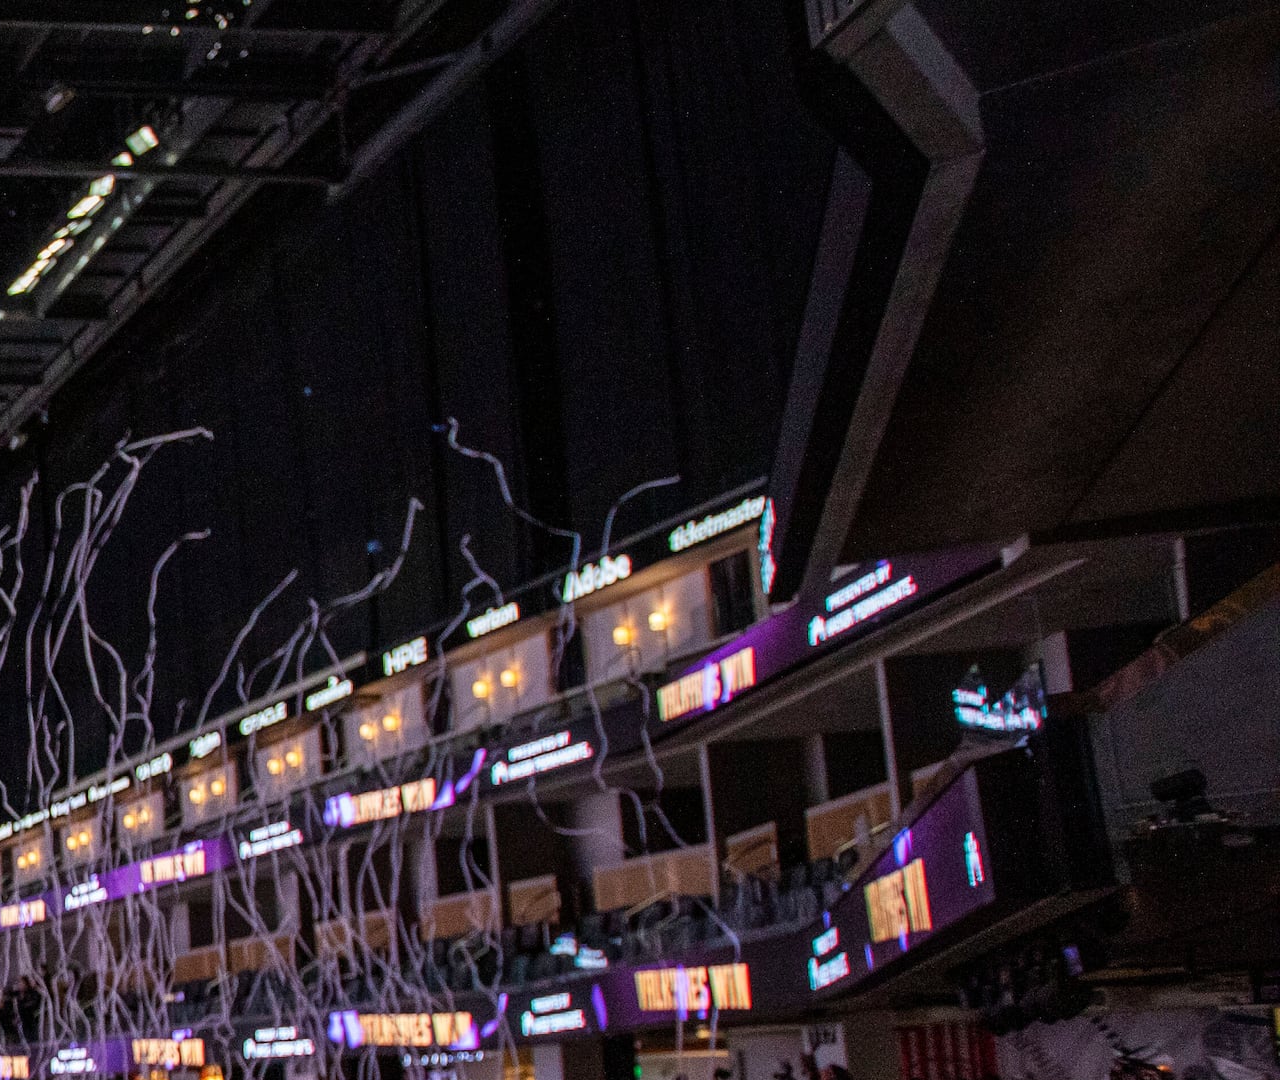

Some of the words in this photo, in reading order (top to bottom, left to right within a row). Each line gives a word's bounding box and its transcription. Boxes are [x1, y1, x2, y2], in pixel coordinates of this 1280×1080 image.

[669, 495, 766, 552] ticketmaster
[562, 554, 632, 603] Adobe
[466, 602, 520, 638] verizon
[383, 636, 428, 676] HPE
[240, 702, 288, 736] ORACLE
